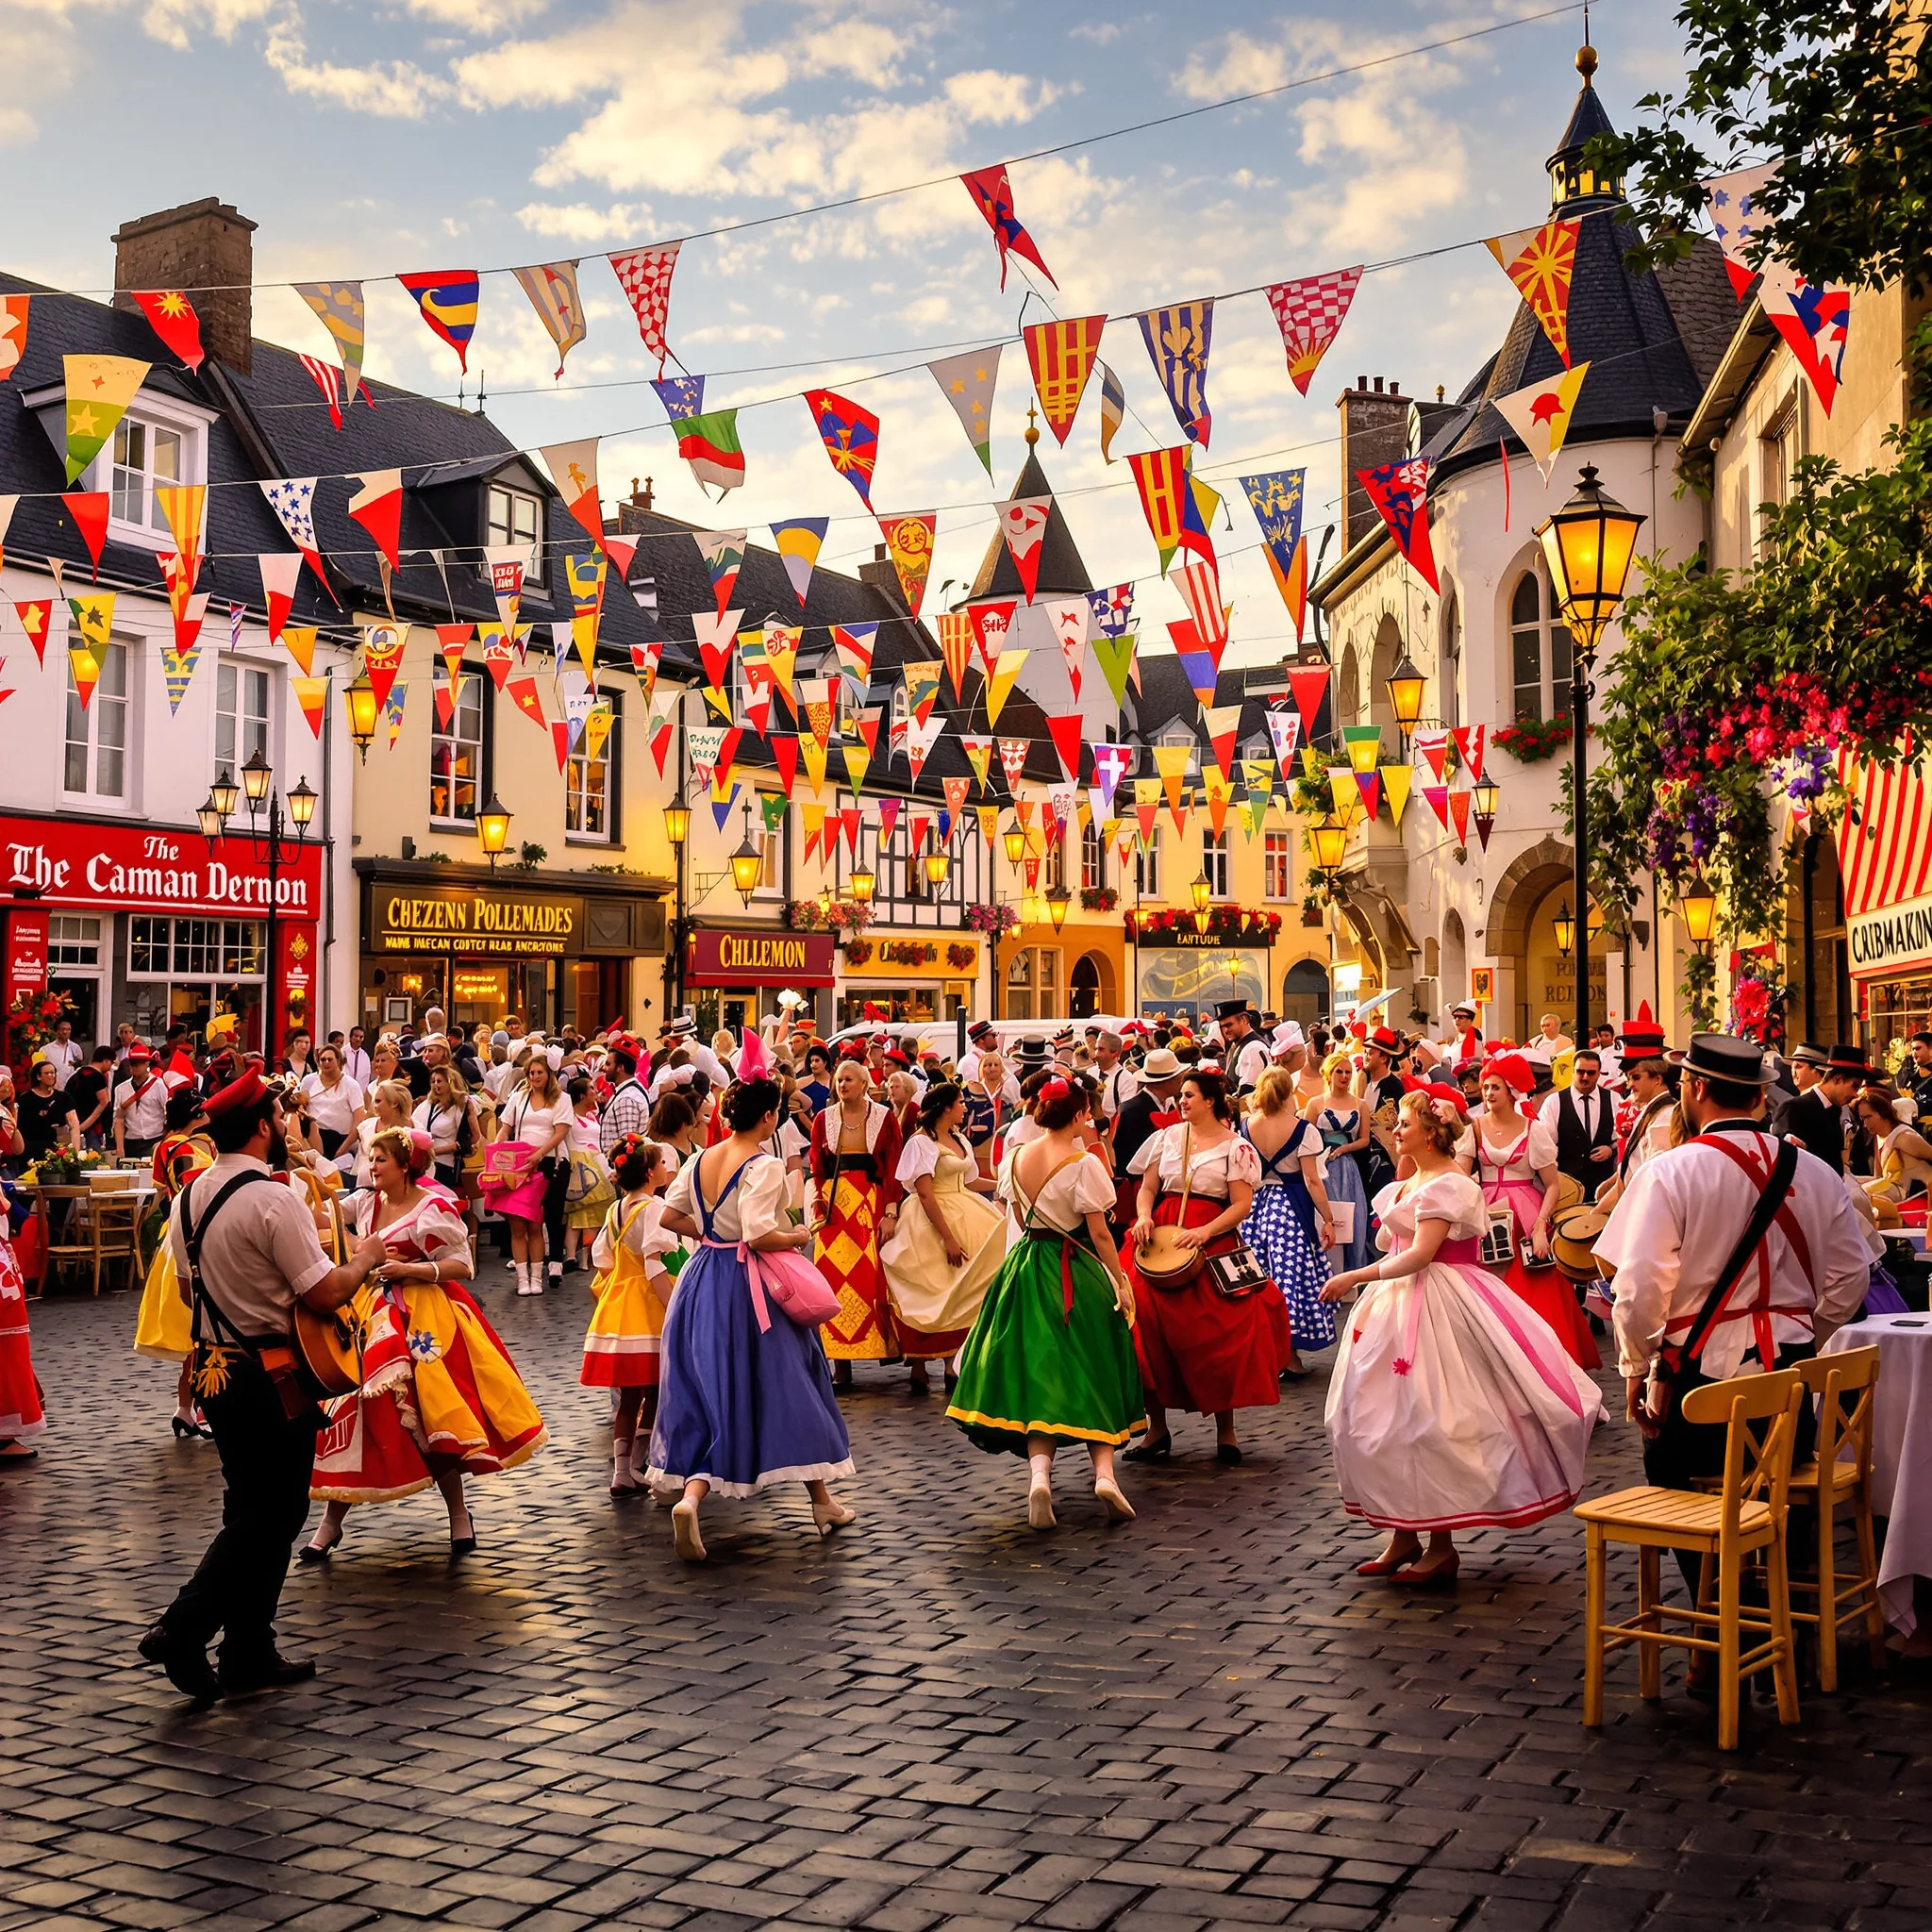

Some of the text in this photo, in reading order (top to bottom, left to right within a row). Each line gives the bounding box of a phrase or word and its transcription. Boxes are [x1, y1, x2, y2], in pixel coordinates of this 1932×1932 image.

[143, 836, 179, 861] The
[6, 842, 71, 892] The
[473, 898, 574, 934] POLLEMADES
